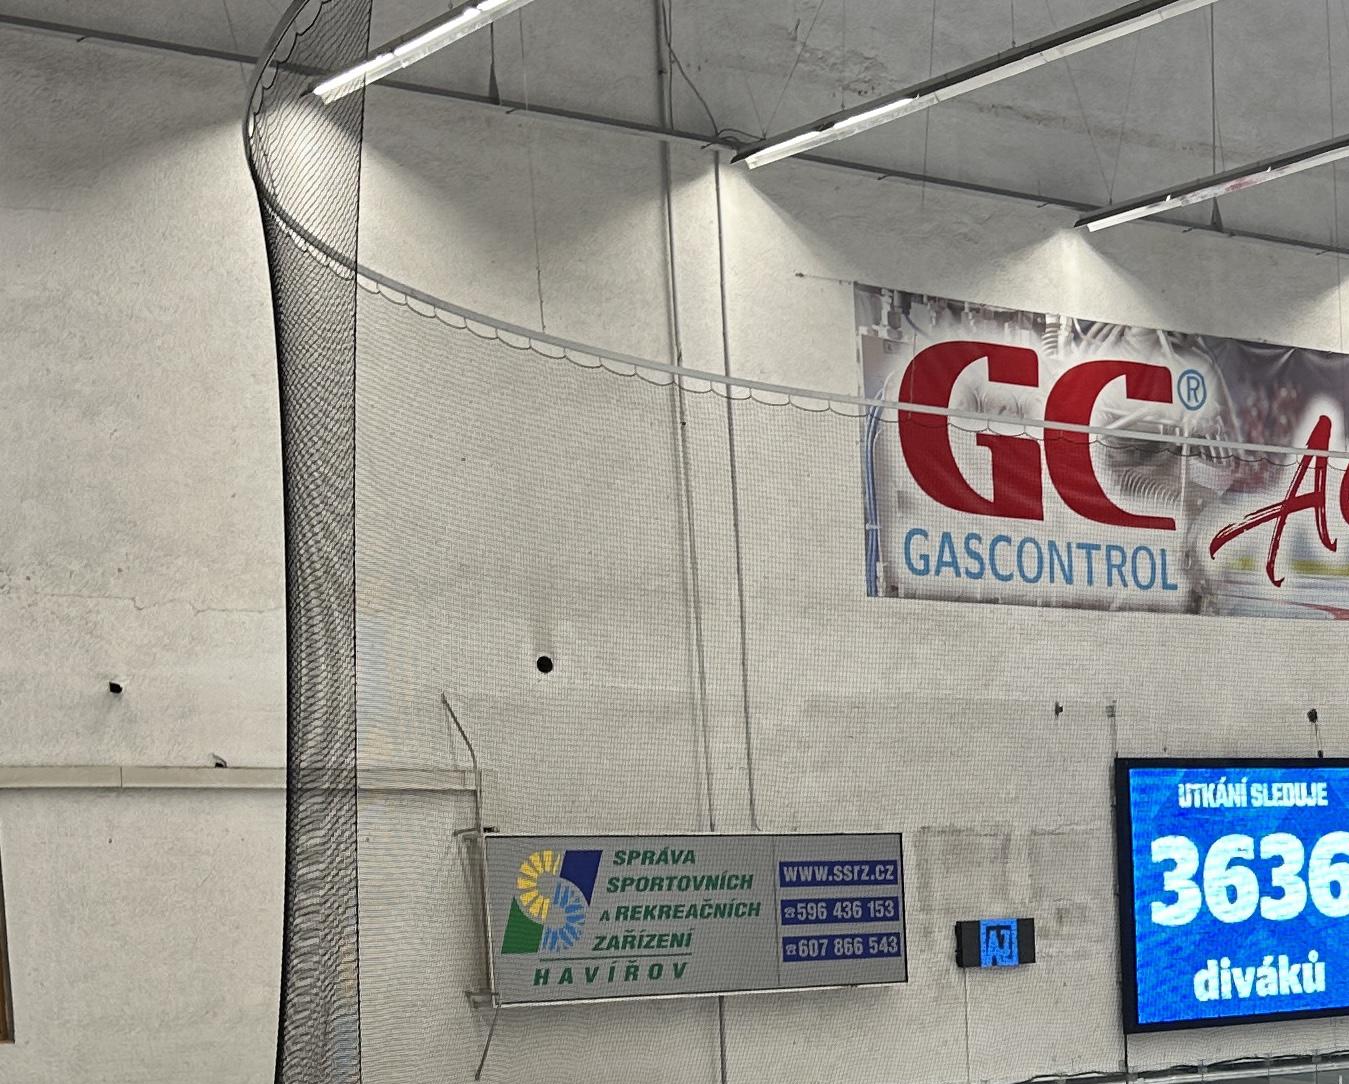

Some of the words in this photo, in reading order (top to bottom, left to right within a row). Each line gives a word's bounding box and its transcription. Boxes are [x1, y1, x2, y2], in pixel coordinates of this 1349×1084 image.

[899, 339, 1176, 531] GC
[903, 526, 1179, 592] GASCONTROL
[1178, 777, 1248, 808] UTKÁNÍ
[1251, 782, 1328, 807] SLEDUJE
[613, 846, 696, 866] SPRÁVA
[606, 870, 754, 893] SPORTOVNÍCH
[783, 864, 894, 882] www.ssrz.cz
[600, 910, 610, 921] A
[615, 899, 762, 921] REKREAČNÍCH
[797, 901, 827, 920] 596
[833, 901, 862, 919] 436
[867, 900, 894, 918] 153
[592, 927, 695, 951] ZAŘÍZENÍ
[798, 938, 828, 957] 607
[833, 937, 864, 956] 866
[869, 935, 898, 954] 543
[534, 960, 689, 987] HAVÍŘOV
[1193, 949, 1326, 1002] diváků
